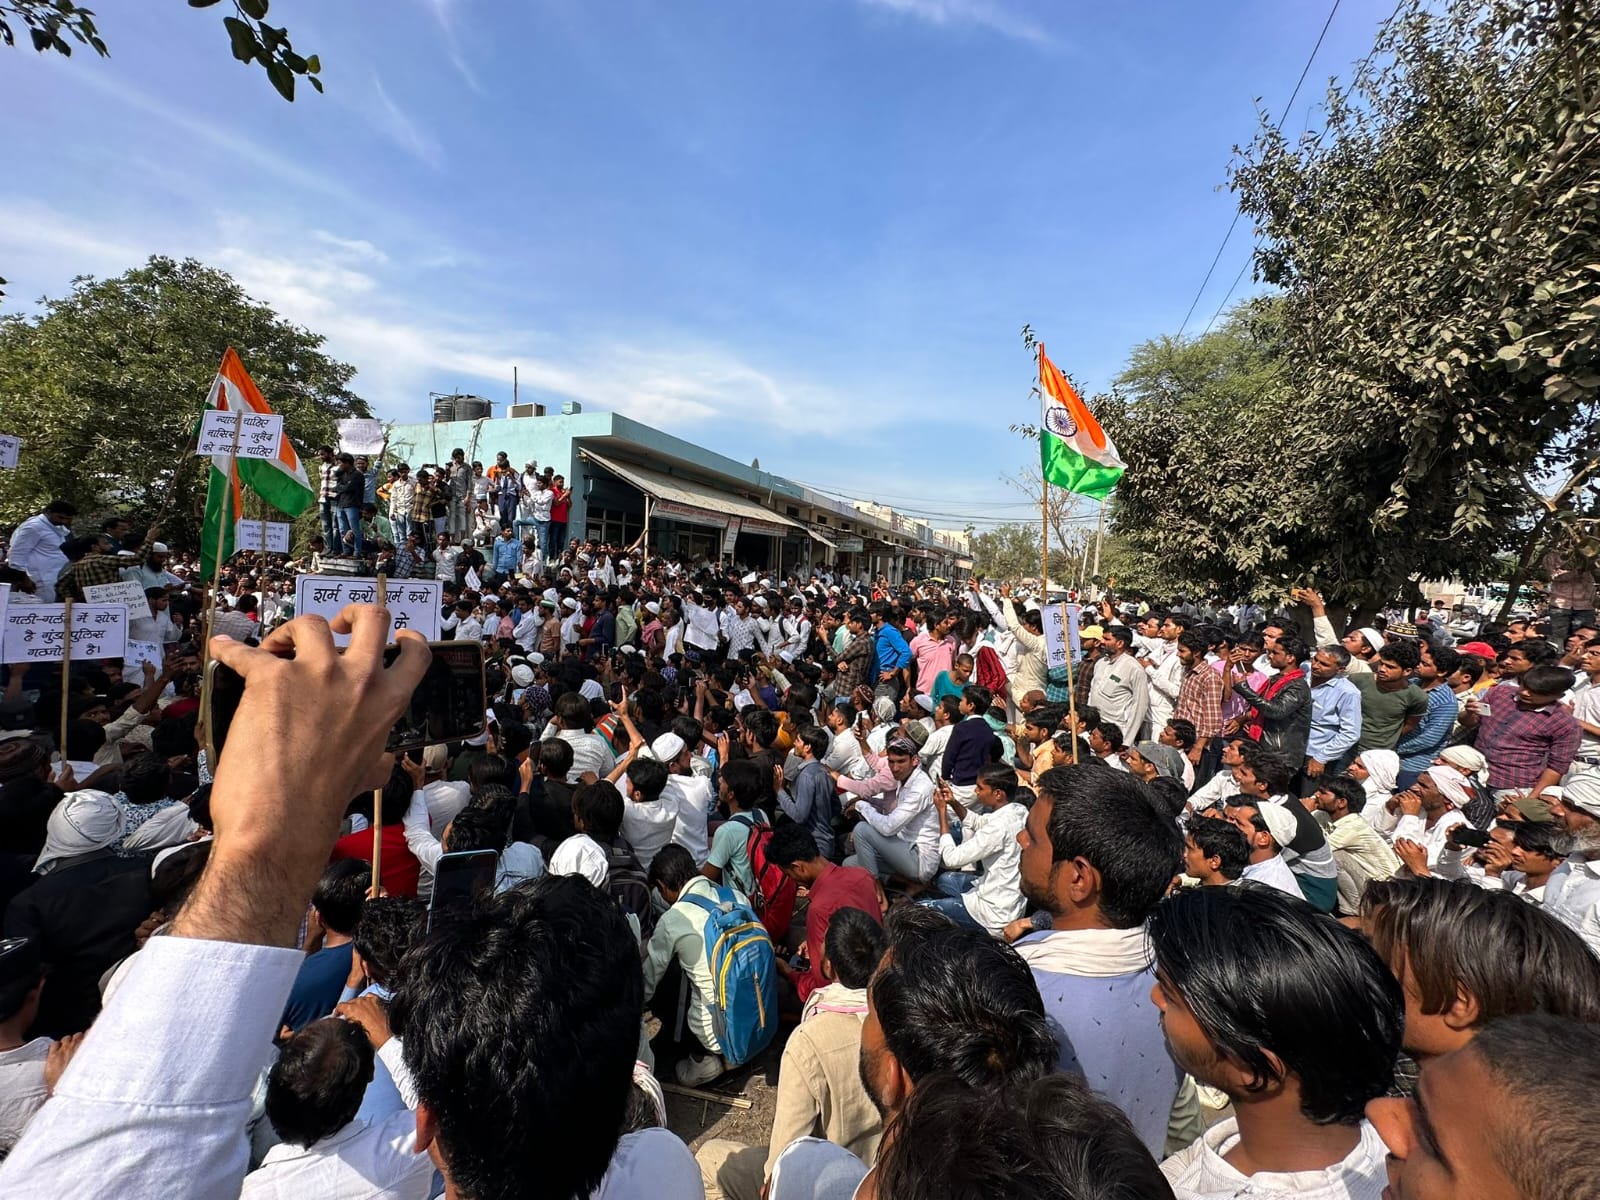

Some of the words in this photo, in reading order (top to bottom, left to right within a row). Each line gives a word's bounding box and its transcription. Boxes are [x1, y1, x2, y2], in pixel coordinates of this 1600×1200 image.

[216, 416, 237, 424] न्याय
[243, 416, 270, 428] चाहिए
[251, 431, 273, 444] जुनैद
[202, 442, 215, 452] को
[247, 444, 274, 457] चाहिए
[313, 584, 343, 603] शर्म
[348, 586, 376, 603] करो
[408, 587, 432, 603] करो
[75, 612, 88, 623] में
[24, 629, 36, 642] है
[70, 628, 106, 643] पुलिस
[27, 644, 72, 657] गठजो
